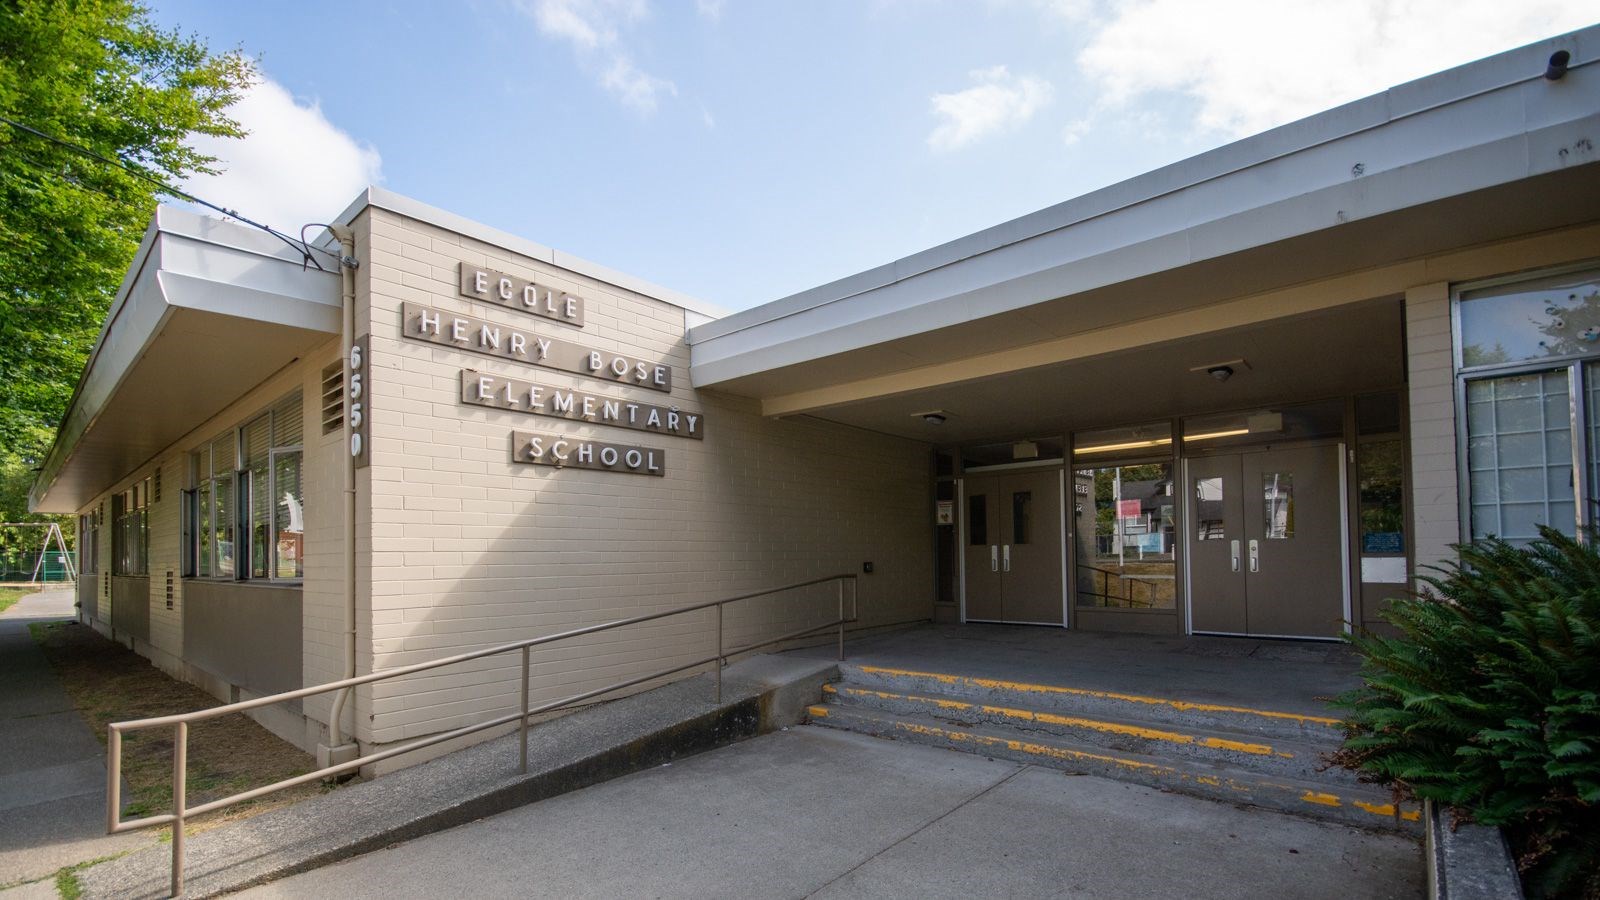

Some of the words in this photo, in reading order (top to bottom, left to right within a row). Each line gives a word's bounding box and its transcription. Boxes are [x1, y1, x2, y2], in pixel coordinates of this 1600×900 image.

[420, 309, 551, 360] HENRY
[588, 350, 667, 386] BOSE
[350, 345, 361, 457] 6550
[477, 376, 698, 434] ELEMENTARY
[528, 437, 660, 471] SCHOOL
